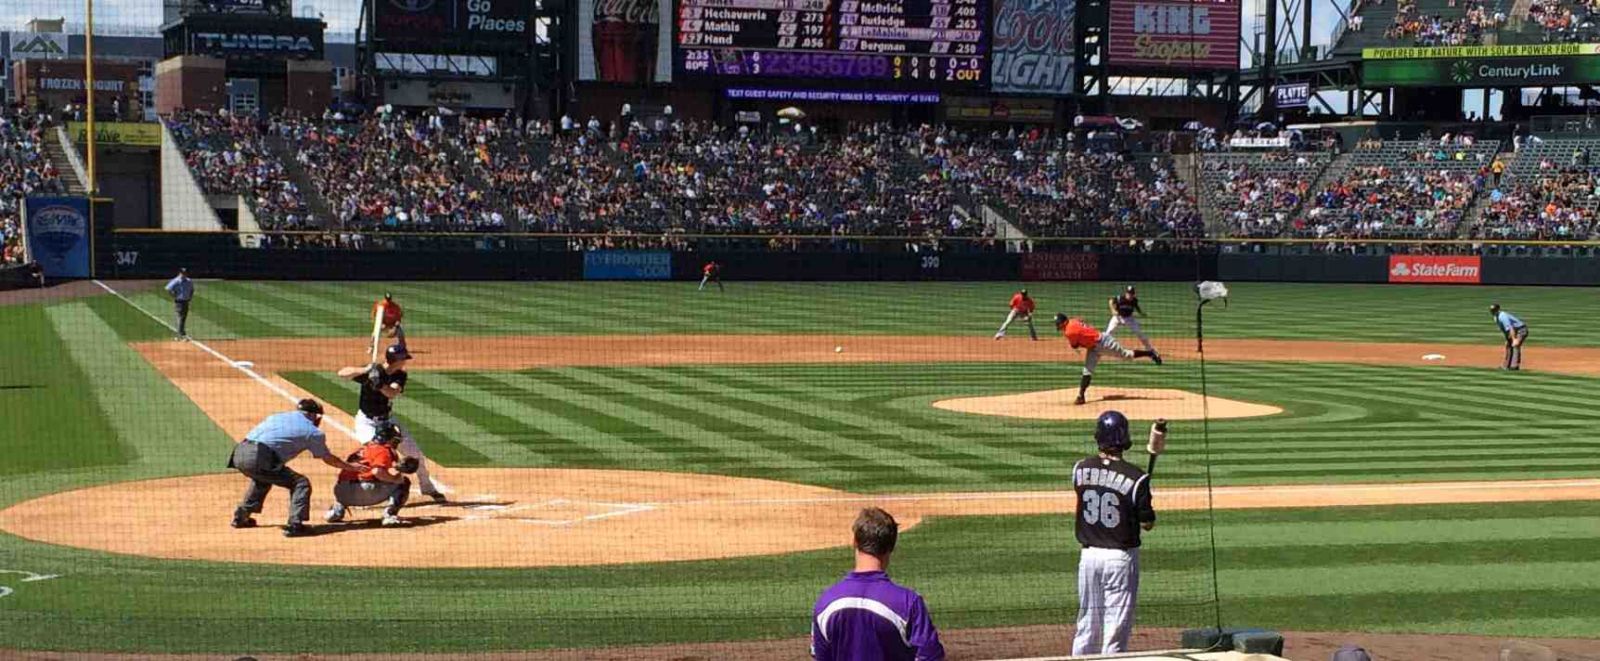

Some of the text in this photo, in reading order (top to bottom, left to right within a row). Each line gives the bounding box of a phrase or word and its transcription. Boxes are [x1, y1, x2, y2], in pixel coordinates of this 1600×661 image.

[467, 0, 491, 12] Go
[860, 3, 903, 13] McBride
[704, 9, 767, 20] Hechavarria
[802, 12, 824, 23] .273
[860, 15, 905, 27] Rutledge
[1133, 4, 1211, 34] KING
[467, 15, 526, 32] Places
[704, 20, 740, 32] Mathis
[801, 25, 824, 35] .197
[197, 33, 314, 51] TUNDRA
[704, 34, 733, 45] Hand
[801, 36, 824, 47] .056
[860, 41, 906, 52] Bergman
[1132, 33, 1212, 65] Soopers
[1373, 45, 1580, 58] POWERED BY NATURE WITH SOLAR POWER FROM
[946, 70, 981, 81] 2 OUT
[992, 53, 1075, 92] LIGHT
[1478, 64, 1562, 79] CenturyLink
[40, 78, 125, 91] FROZEN YGURT
[728, 89, 744, 98] TEXT
[744, 89, 766, 98] GUEST
[767, 90, 792, 99] SAFETY
[792, 91, 807, 99] AND
[1277, 86, 1307, 99] PLATTE
[116, 251, 138, 266] 347
[921, 256, 940, 268] 390
[1076, 467, 1135, 496] BERGMAN
[1082, 489, 1120, 528] 36
